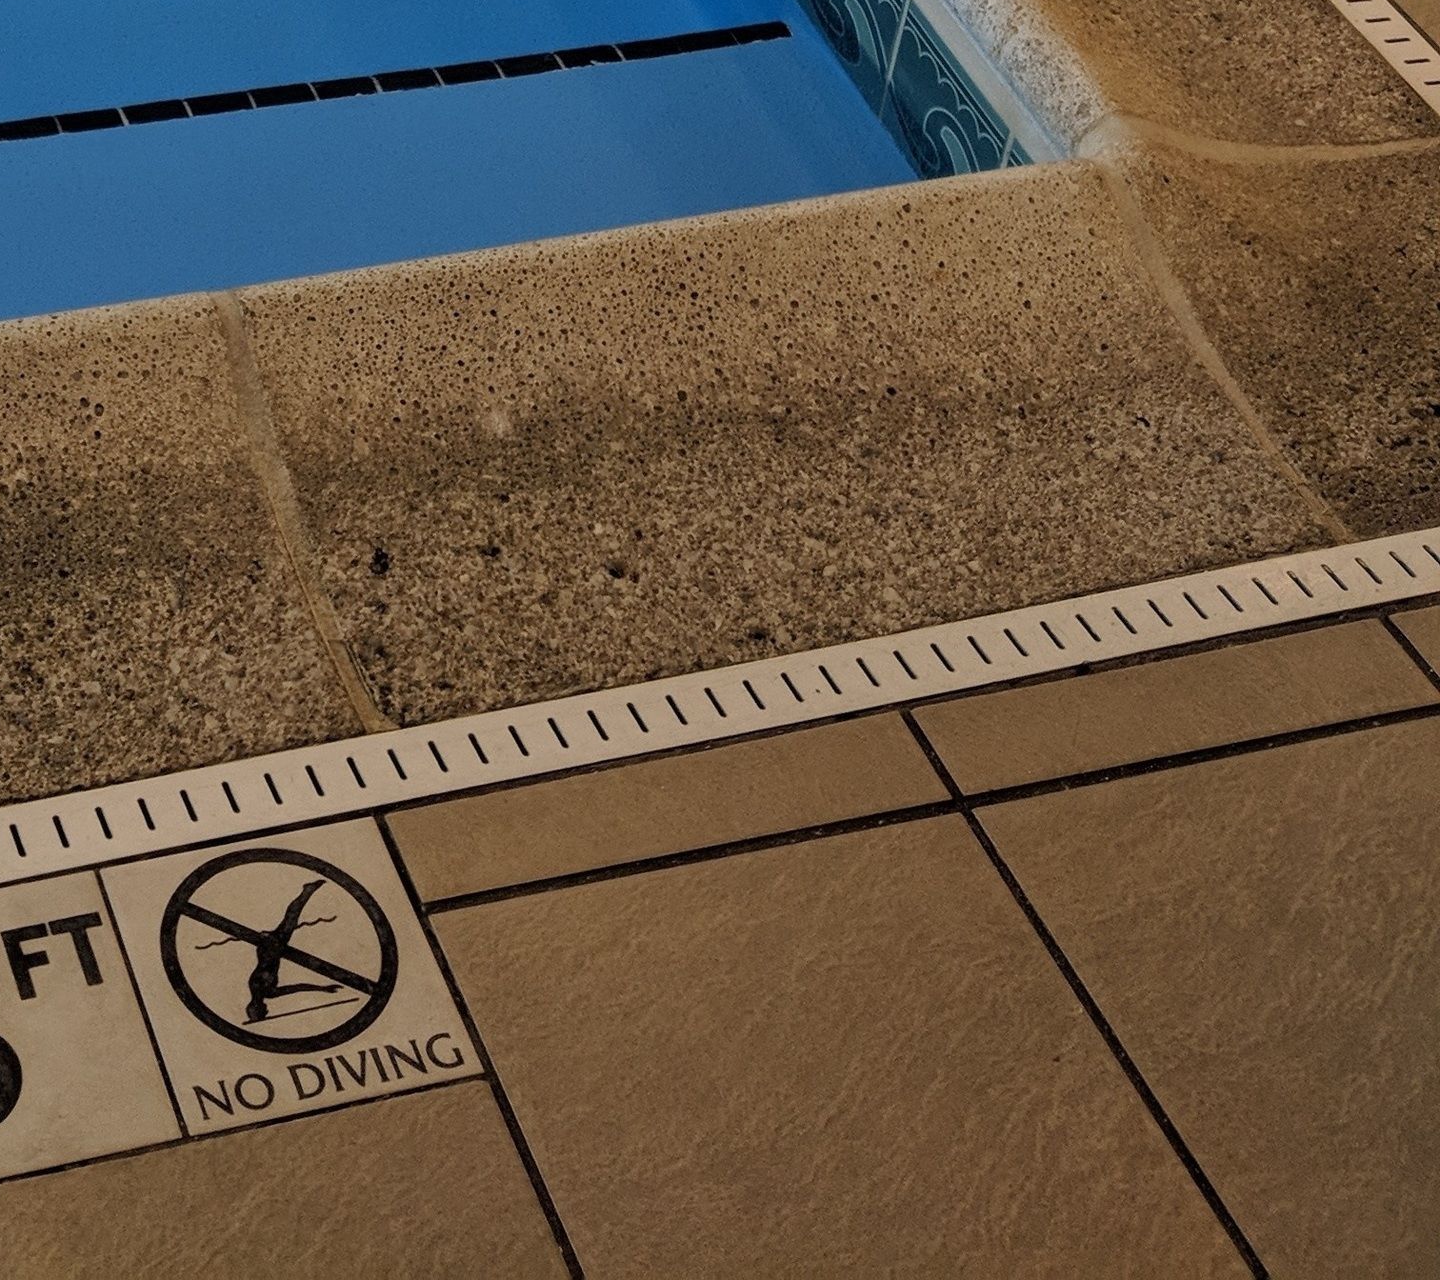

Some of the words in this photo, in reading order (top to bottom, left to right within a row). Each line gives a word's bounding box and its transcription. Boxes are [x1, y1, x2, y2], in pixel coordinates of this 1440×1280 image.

[0, 912, 104, 1001] FT
[193, 1072, 275, 1121] NO
[288, 1032, 465, 1101] DIVING
